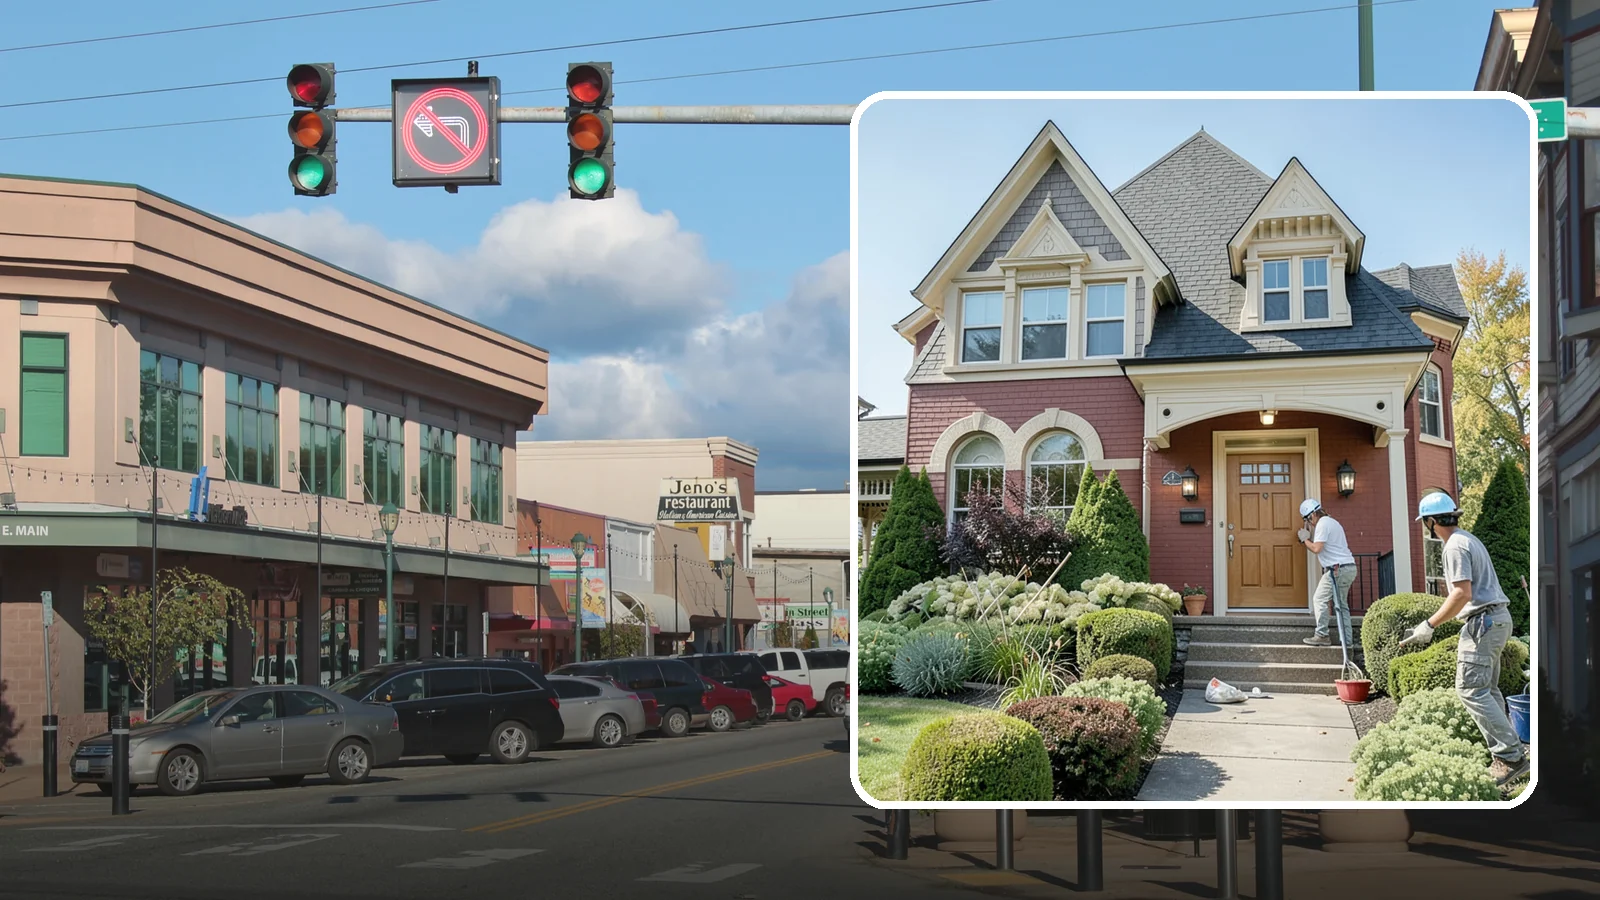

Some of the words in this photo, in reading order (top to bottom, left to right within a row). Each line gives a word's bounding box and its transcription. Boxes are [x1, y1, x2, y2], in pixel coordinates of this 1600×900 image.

[670, 480, 727, 494] Jeno's
[665, 496, 731, 509] restaurant
[658, 509, 682, 519] Italian
[686, 509, 714, 519] American
[714, 509, 737, 519] Cuisine
[2, 525, 13, 536] E.
[15, 525, 49, 536] MAIN
[797, 607, 829, 617] Street
[791, 619, 823, 627] lass
